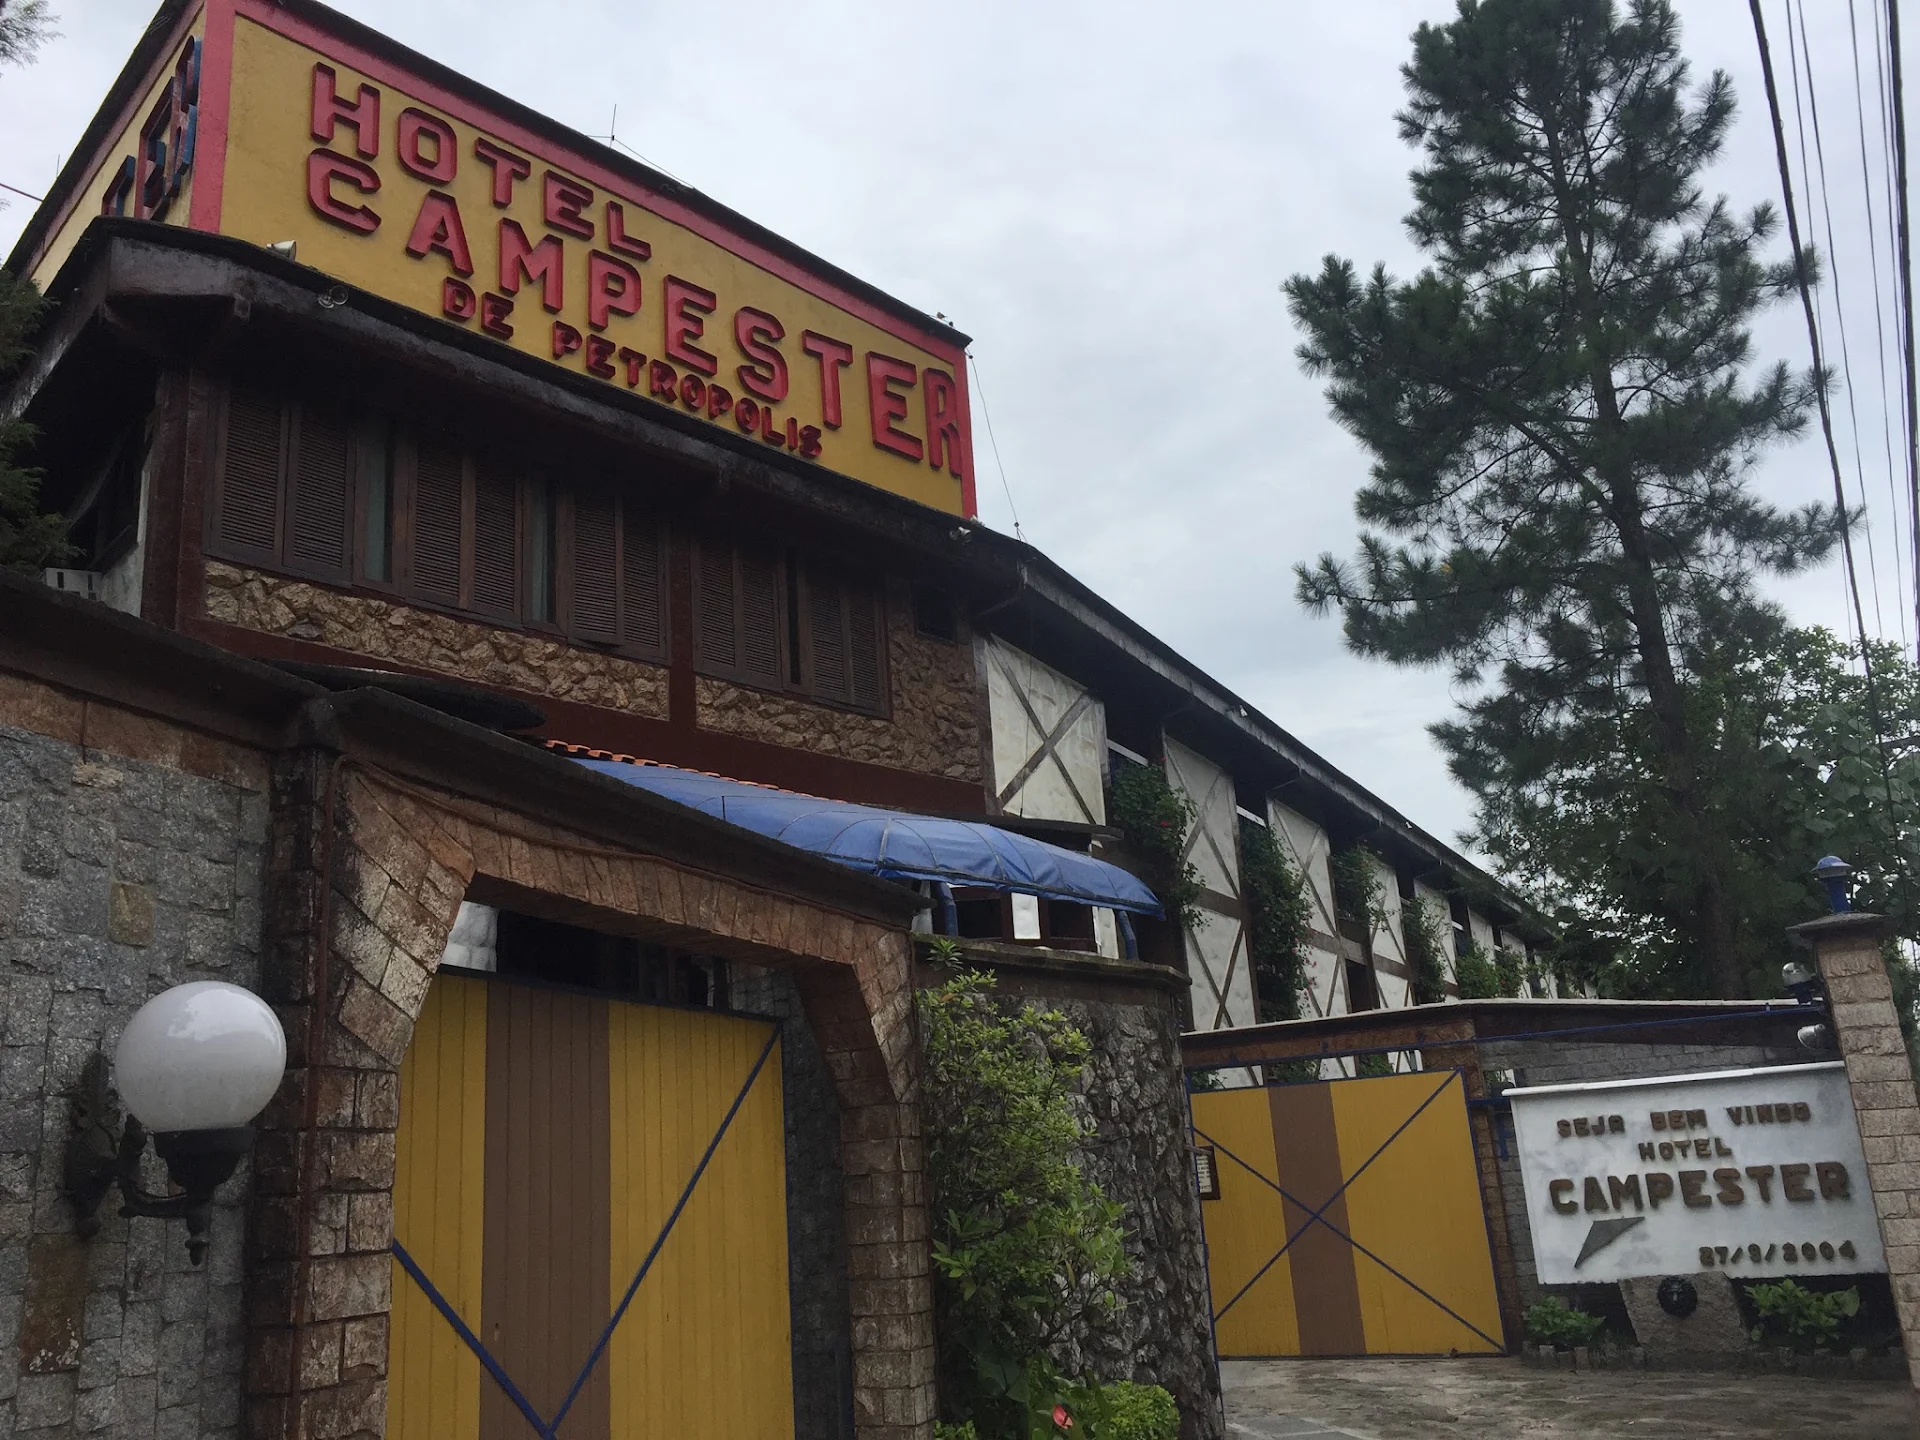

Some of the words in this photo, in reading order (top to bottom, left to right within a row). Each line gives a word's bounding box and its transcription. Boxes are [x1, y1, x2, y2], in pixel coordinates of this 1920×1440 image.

[311, 62, 651, 261] HOTEL
[307, 147, 962, 479] CAMPESTER
[443, 277, 514, 339] DE
[552, 320, 822, 459] PETROPOLIS
[1556, 1114, 1627, 1138] SEJA
[1650, 1109, 1708, 1131] BEM
[1726, 1102, 1812, 1127] VINDO
[1638, 1137, 1733, 1162] HOTEL
[1549, 1161, 1851, 1214] CAMPESTER
